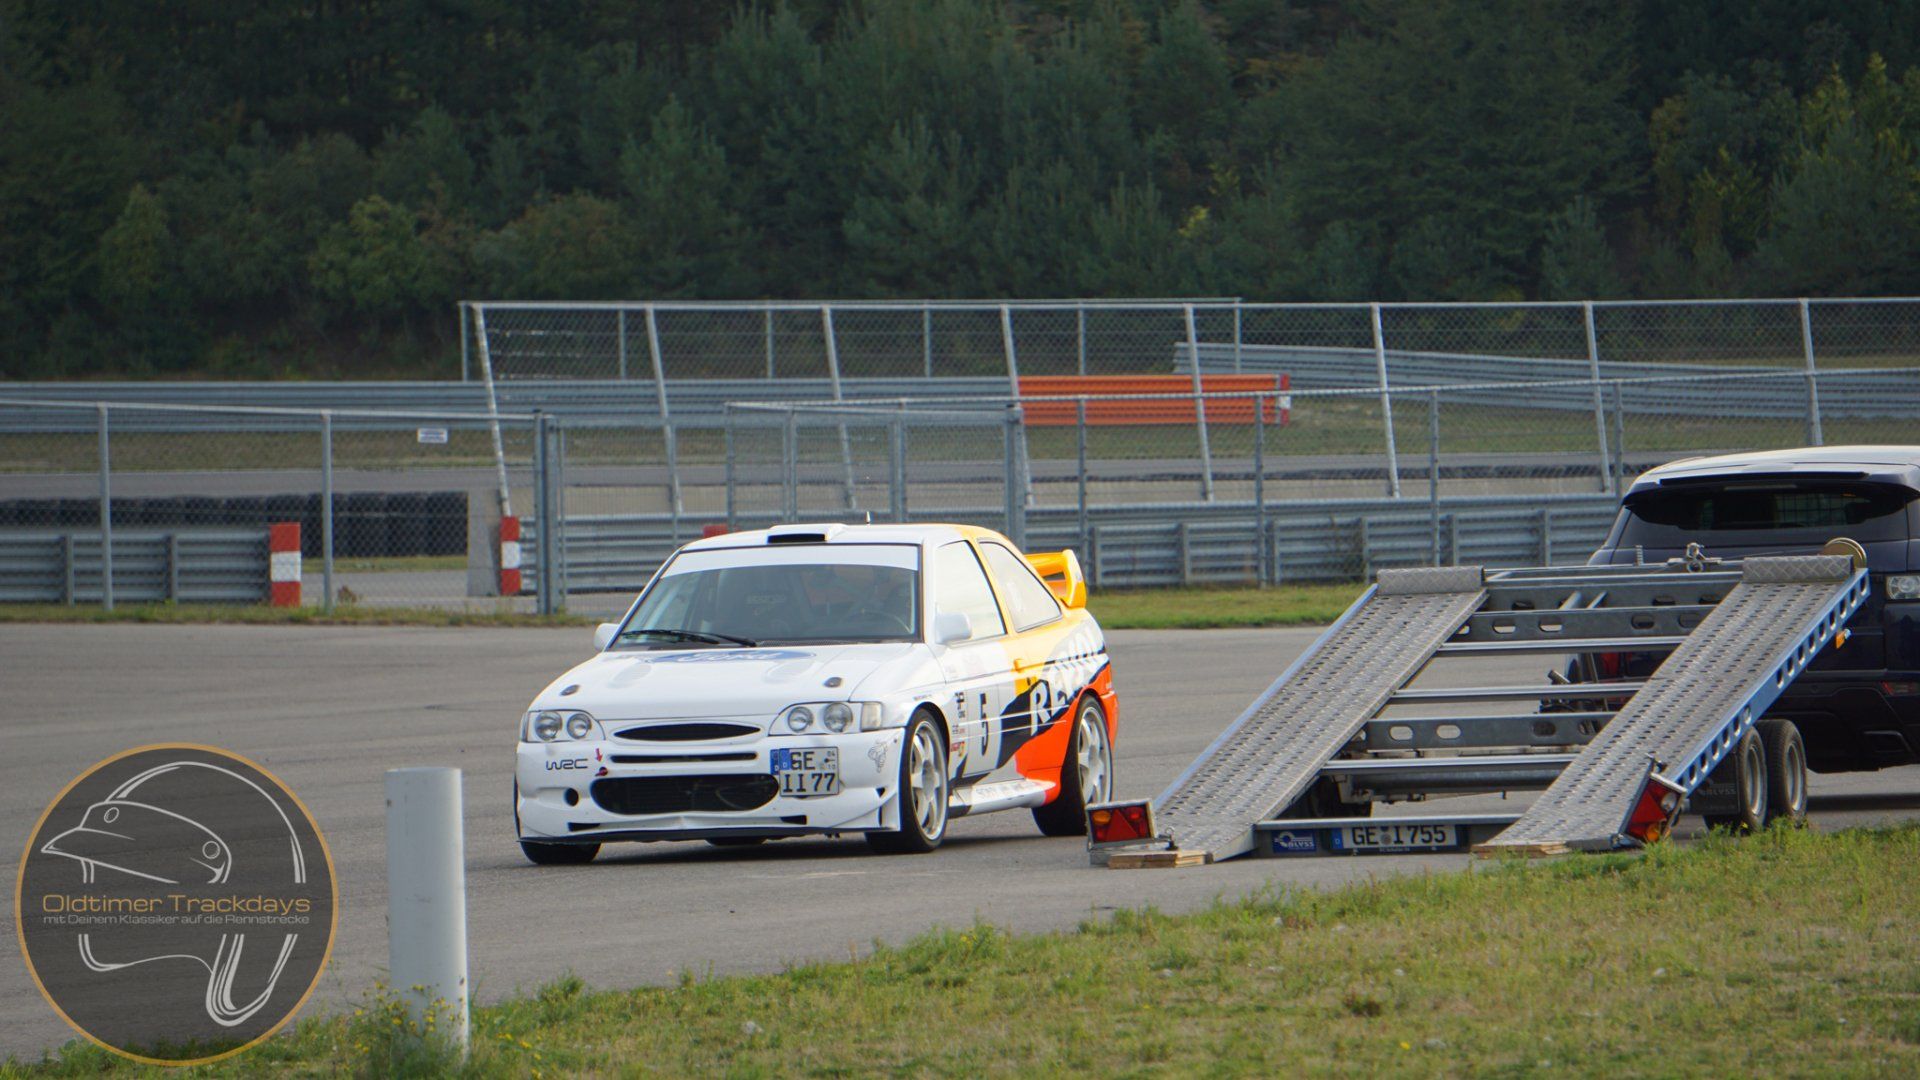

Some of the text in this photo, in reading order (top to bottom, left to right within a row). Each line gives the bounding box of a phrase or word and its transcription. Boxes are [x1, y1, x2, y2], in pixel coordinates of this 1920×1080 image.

[979, 692, 989, 756] 5
[545, 758, 588, 771] WRC
[790, 751, 816, 770] GE
[1352, 825, 1379, 846] GE
